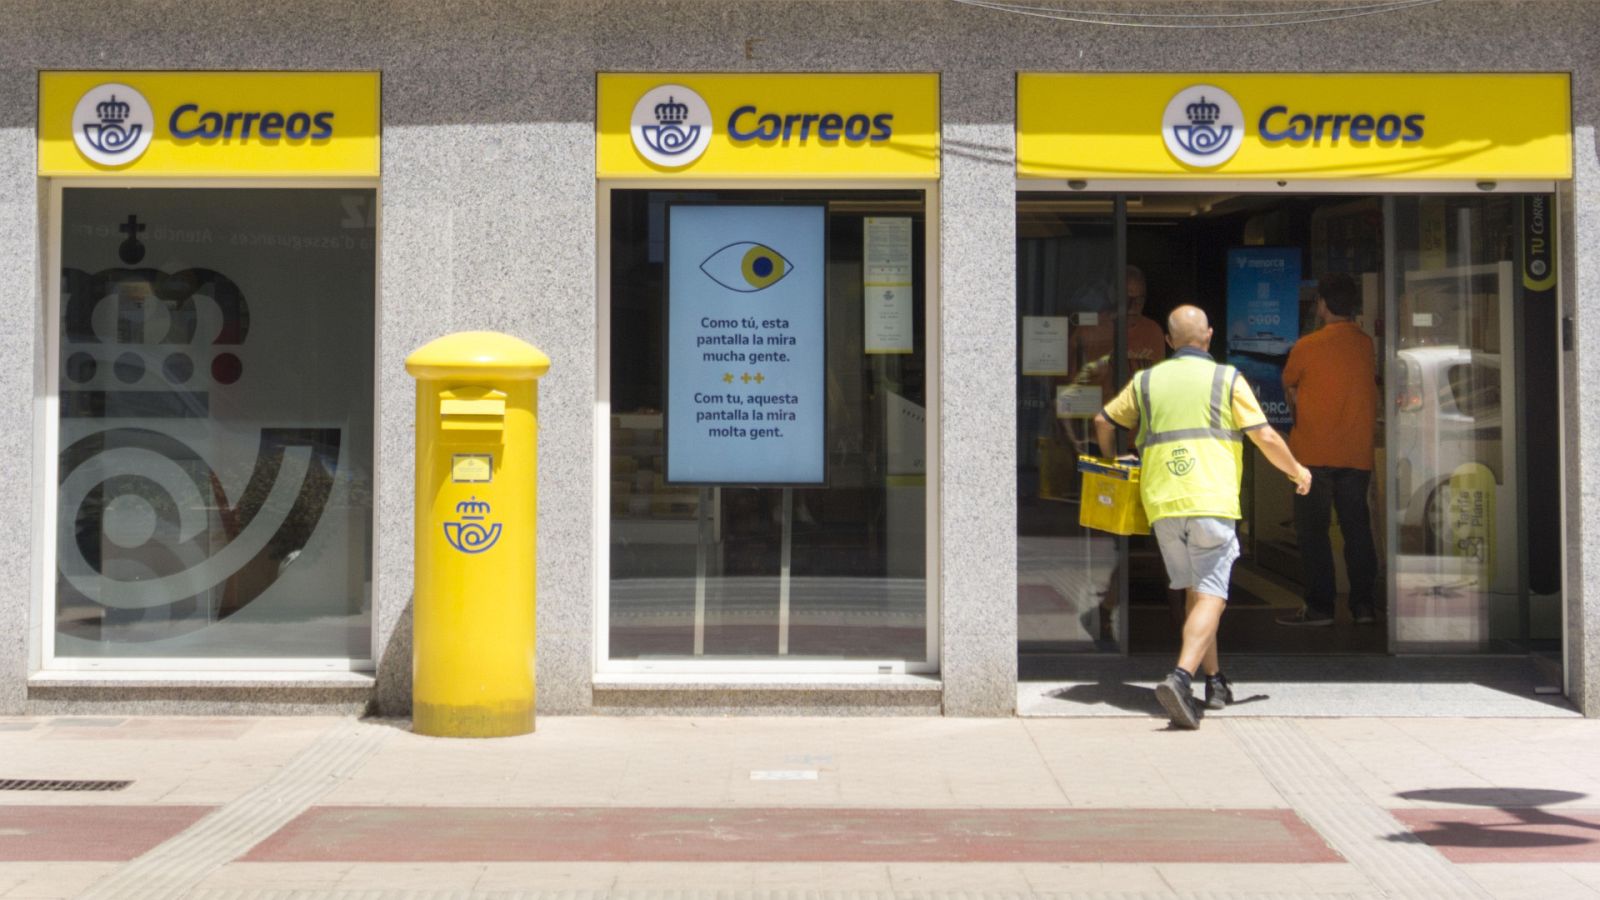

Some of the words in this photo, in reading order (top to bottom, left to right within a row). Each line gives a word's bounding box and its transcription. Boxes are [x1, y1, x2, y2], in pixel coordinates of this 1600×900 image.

[169, 104, 334, 140] Correos
[728, 105, 894, 142] Correos
[1258, 105, 1425, 142] Correos
[1531, 238, 1545, 256] TU
[700, 317, 739, 329] Como
[741, 317, 759, 330] tú,
[762, 318, 790, 329] esta
[696, 334, 750, 348] pantalla
[752, 334, 764, 346] la
[767, 334, 796, 346] mira
[703, 351, 746, 363] mucha
[748, 352, 790, 365] gente.
[694, 392, 721, 404] Com
[726, 393, 744, 405] tu,
[747, 393, 799, 407] aquesta
[696, 409, 749, 423] pantalla
[752, 409, 764, 421] la
[766, 409, 796, 421] mira
[708, 426, 747, 438] molta
[749, 427, 784, 440] gent.
